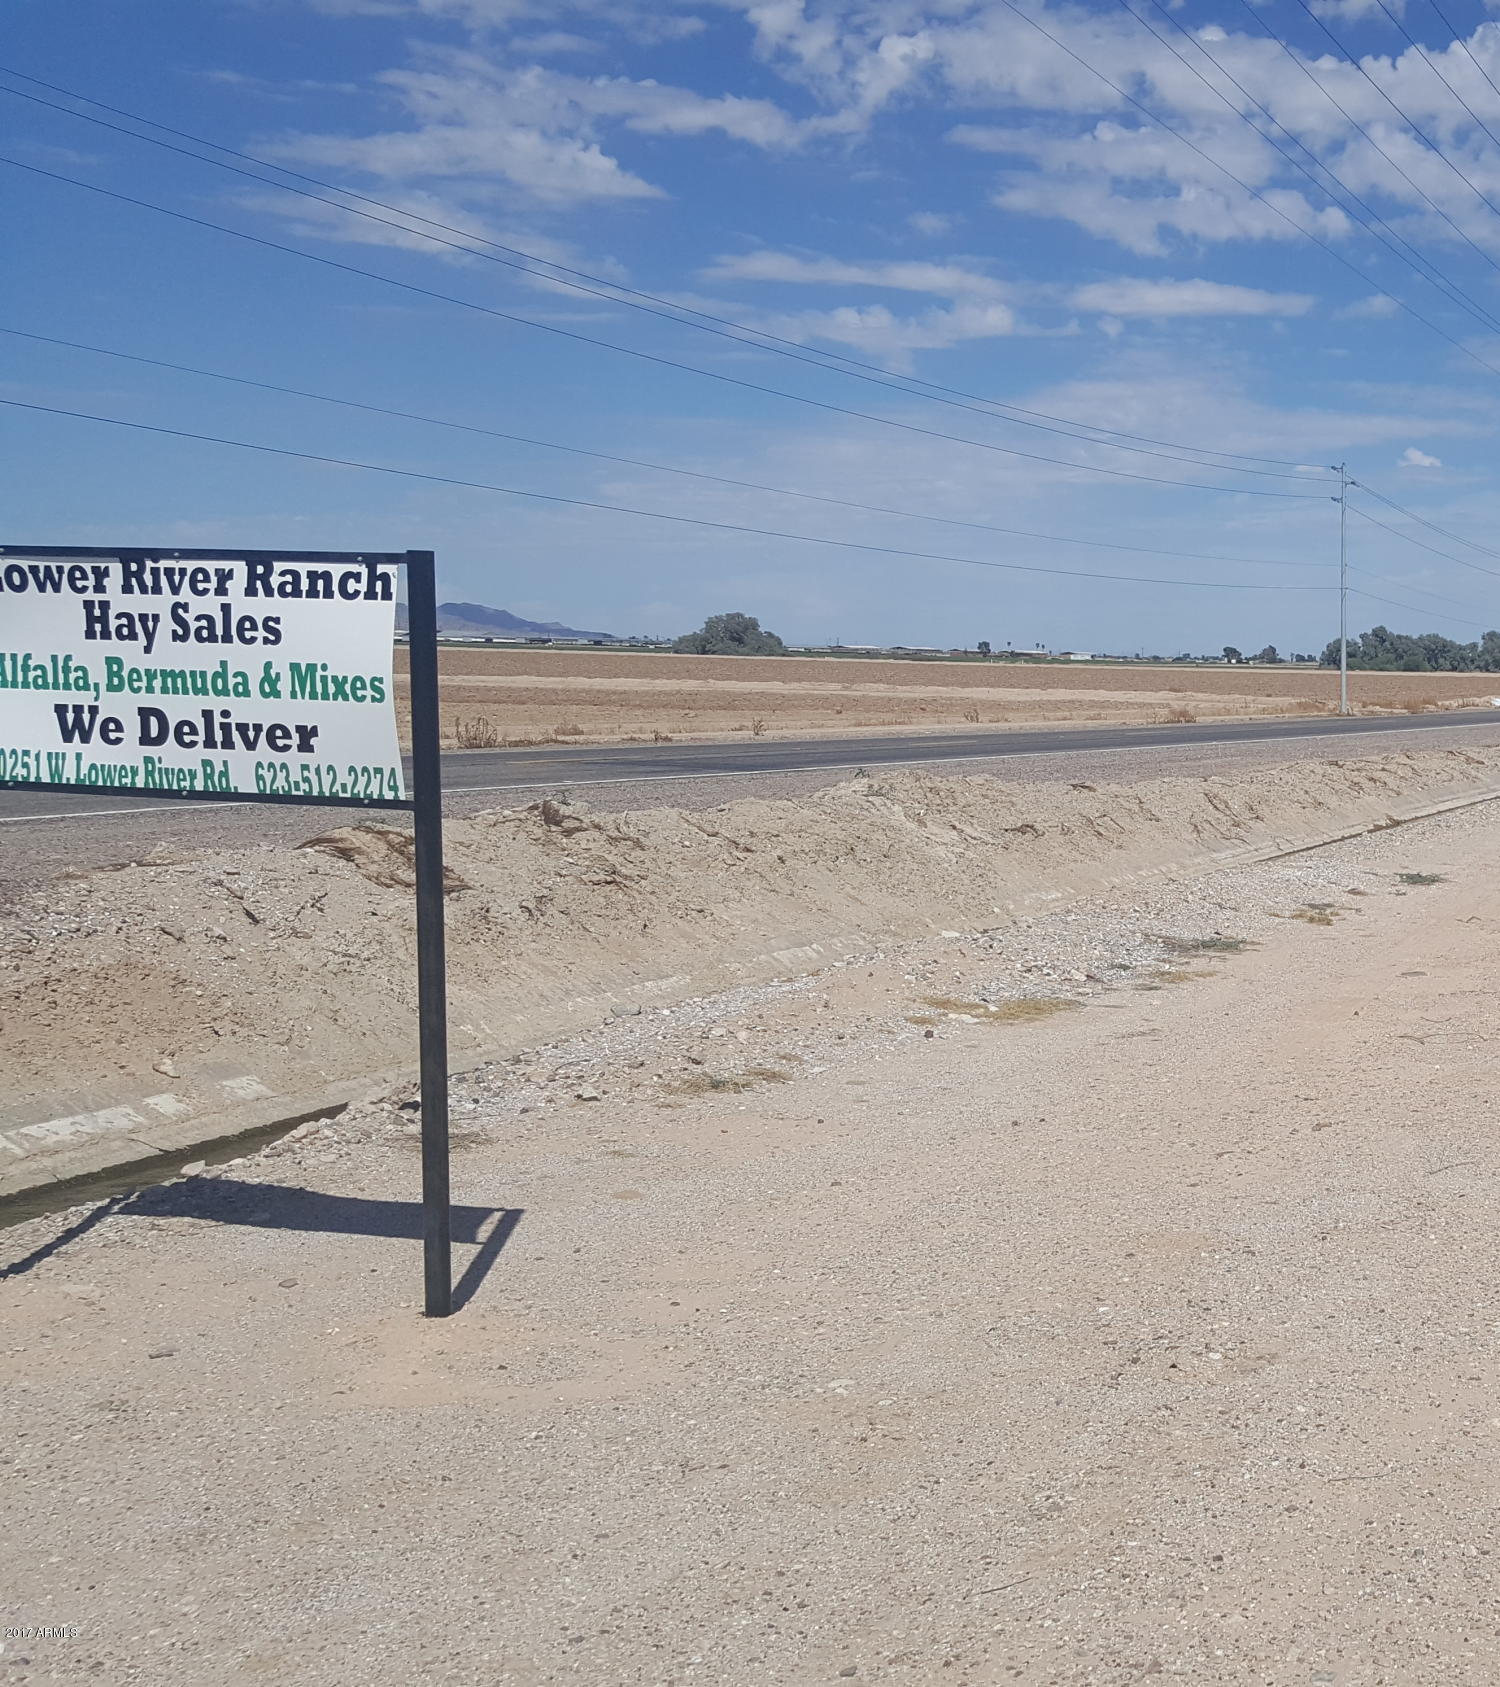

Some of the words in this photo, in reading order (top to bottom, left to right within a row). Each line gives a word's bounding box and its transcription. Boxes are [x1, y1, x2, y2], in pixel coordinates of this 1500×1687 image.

[0, 563, 110, 595] ower
[119, 558, 234, 597] River
[245, 560, 393, 601] Ranch
[83, 600, 160, 654] Hay
[171, 601, 283, 646] Sales
[105, 656, 251, 698] Bermuda
[259, 661, 282, 699] &
[289, 662, 386, 704] Mixes
[54, 704, 125, 746] We
[138, 706, 319, 753] Deliver
[47, 752, 71, 785] W.
[75, 752, 139, 788] Lower
[143, 755, 197, 791] River
[201, 758, 239, 793] Rd.
[255, 760, 400, 800] 623-512-2274
